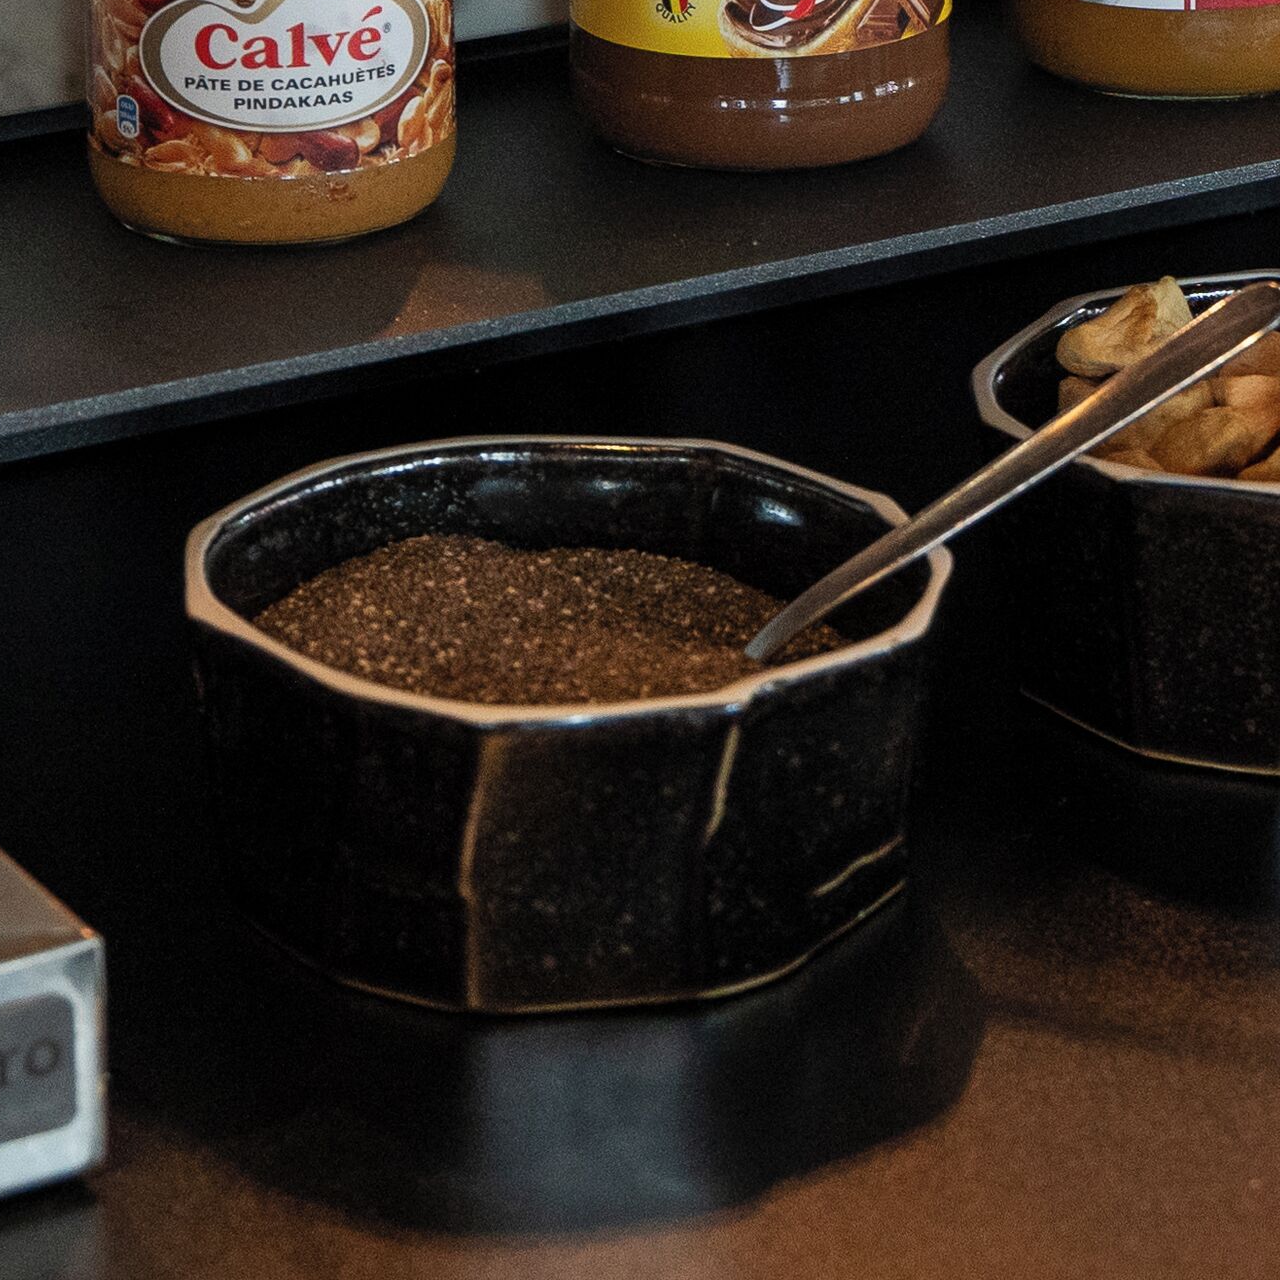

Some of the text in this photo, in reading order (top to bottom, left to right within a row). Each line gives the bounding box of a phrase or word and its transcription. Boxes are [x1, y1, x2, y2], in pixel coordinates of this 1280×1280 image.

[656, 3, 696, 23] QUALITY
[194, 5, 384, 70] Calvé
[184, 63, 396, 92] PÂTE DE CACAHUÈTES
[233, 90, 353, 110] PINDAKAAS
